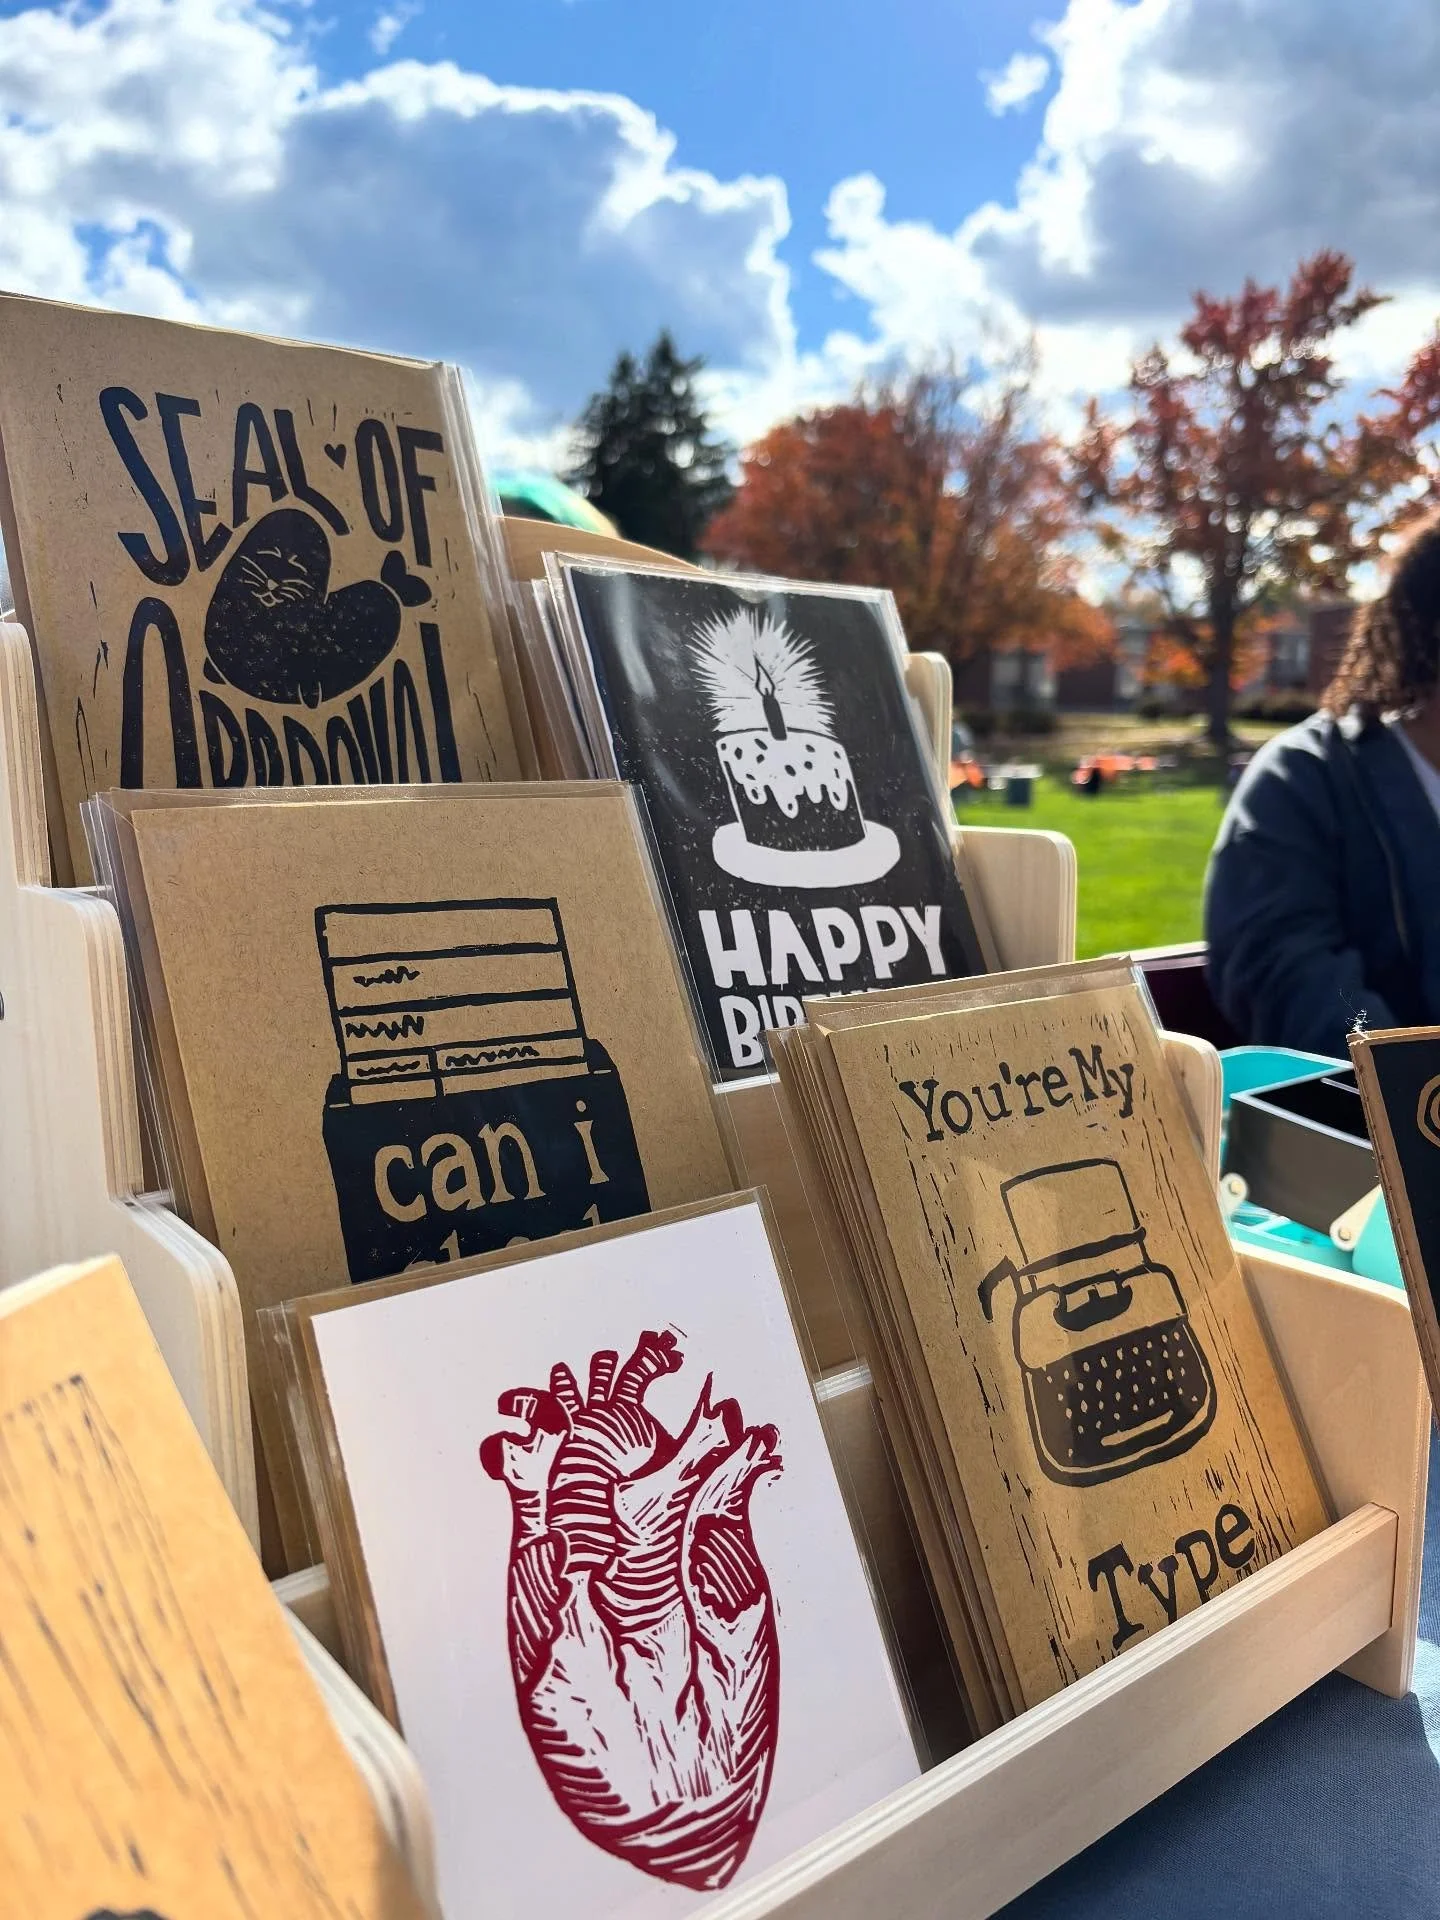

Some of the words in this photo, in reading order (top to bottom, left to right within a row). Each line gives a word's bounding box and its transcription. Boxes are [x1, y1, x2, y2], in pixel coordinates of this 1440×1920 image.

[99, 386, 350, 587] SEAL
[355, 419, 444, 567] OF
[698, 904, 947, 989] HAPPY
[899, 1061, 1074, 1142] You're
[1068, 1044, 1134, 1119] My
[373, 1121, 547, 1223] can
[573, 1099, 610, 1185] i
[1087, 1503, 1256, 1651] Type
